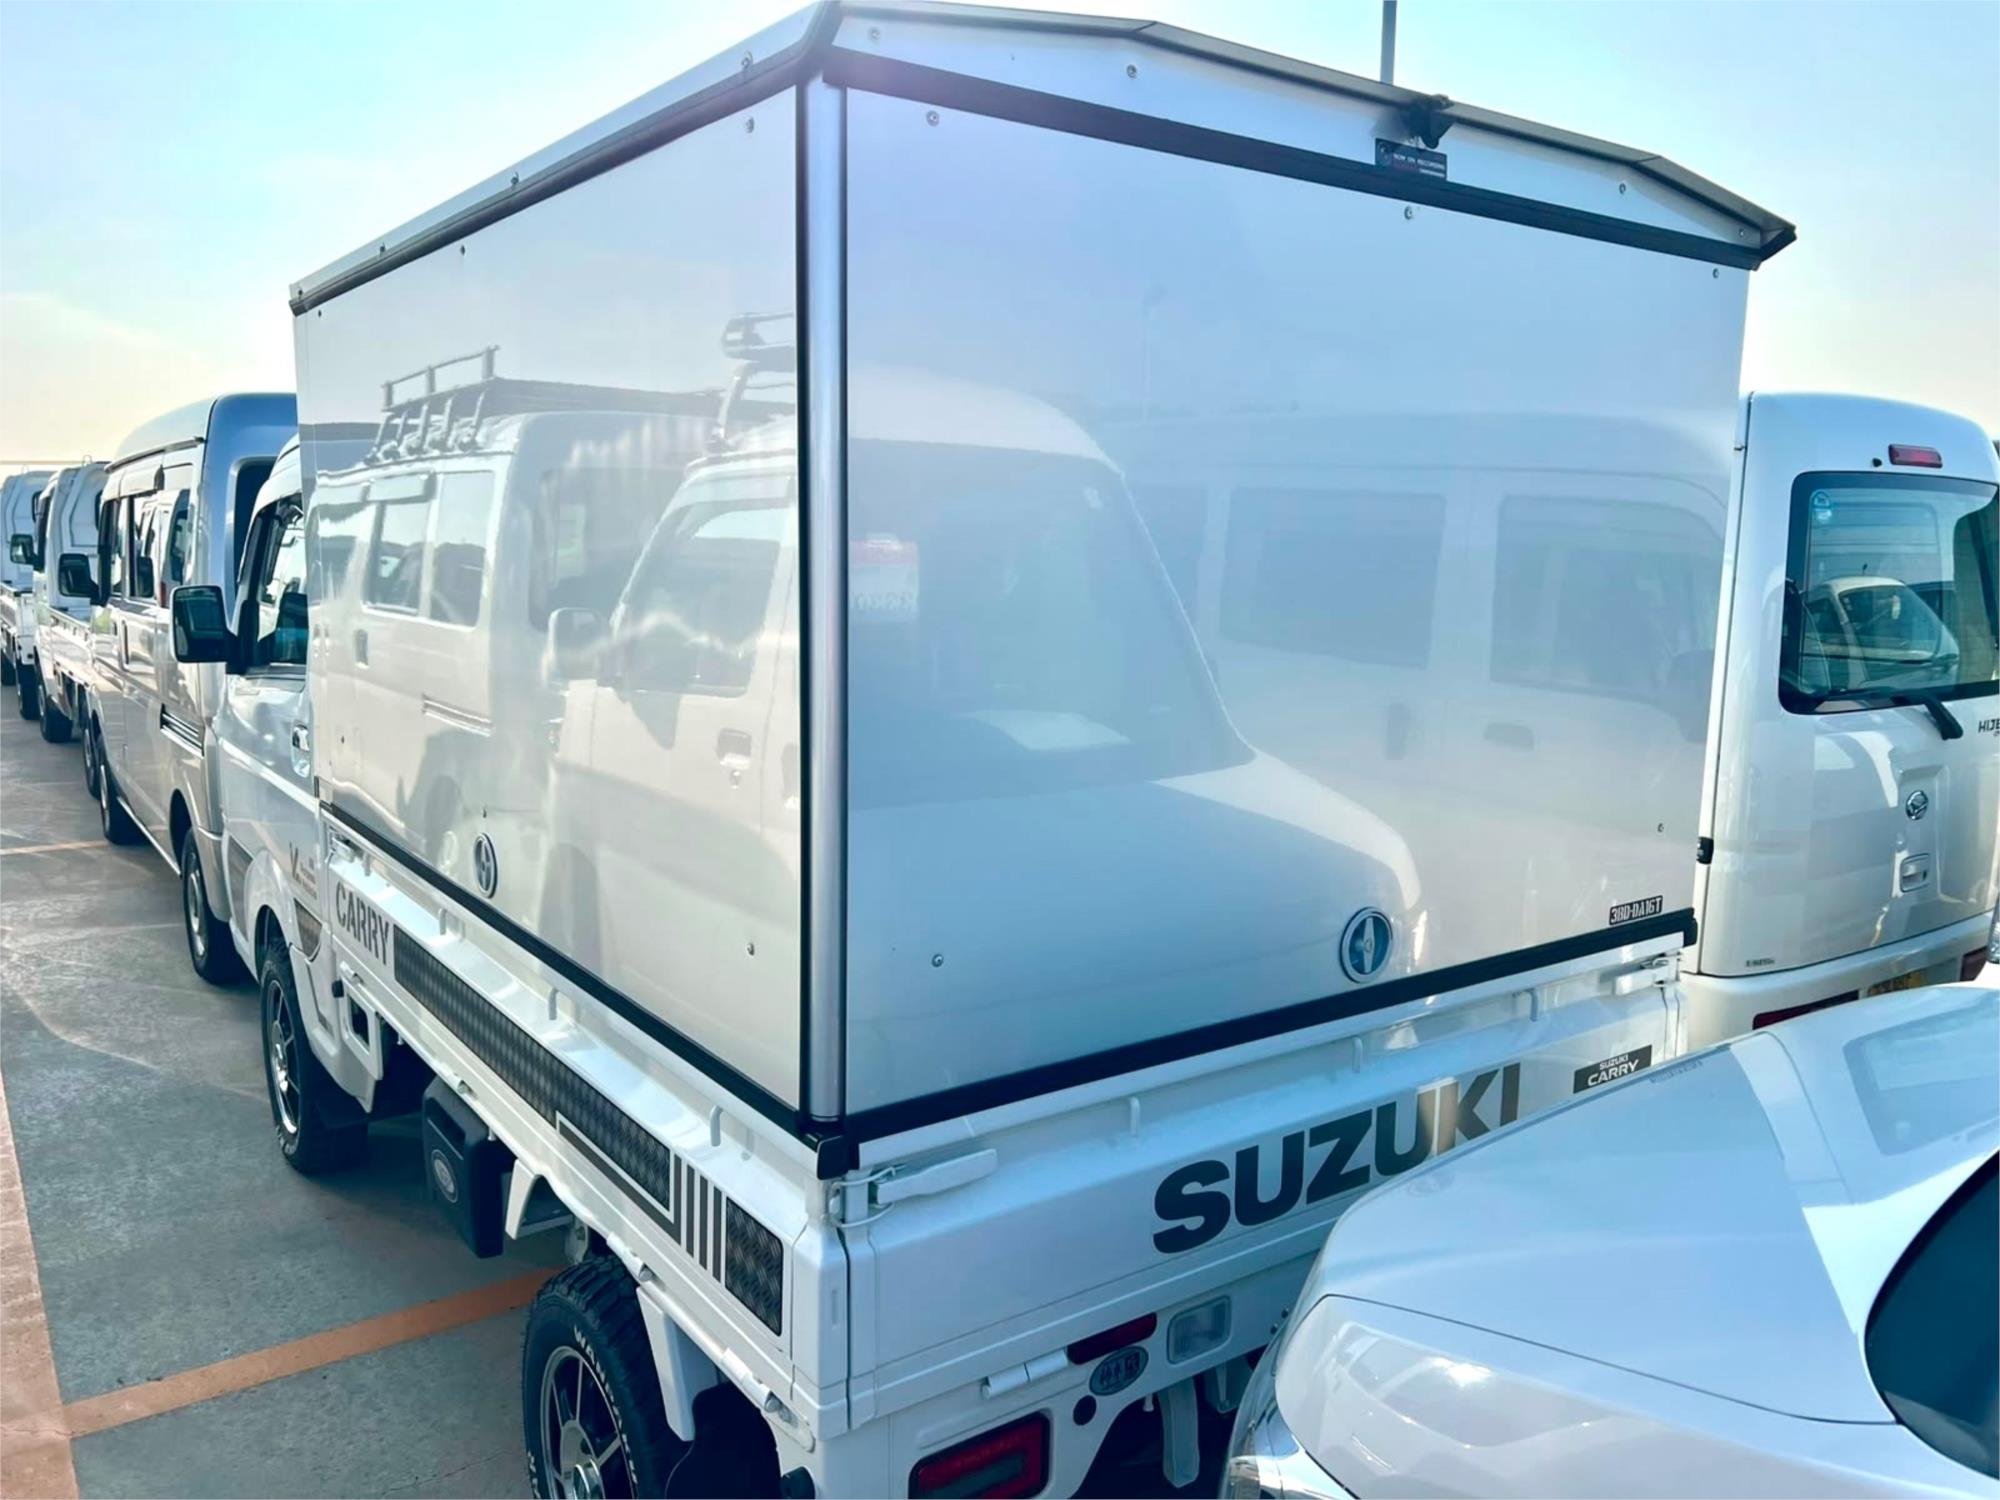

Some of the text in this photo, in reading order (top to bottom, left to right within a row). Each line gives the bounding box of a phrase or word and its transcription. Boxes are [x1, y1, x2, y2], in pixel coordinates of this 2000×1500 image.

[336, 881, 389, 965] CARRY
[1587, 1059, 1639, 1086] CARRY
[1600, 1054, 1628, 1070] SUZUKI
[1153, 1062, 1521, 1254] SUZUKI
